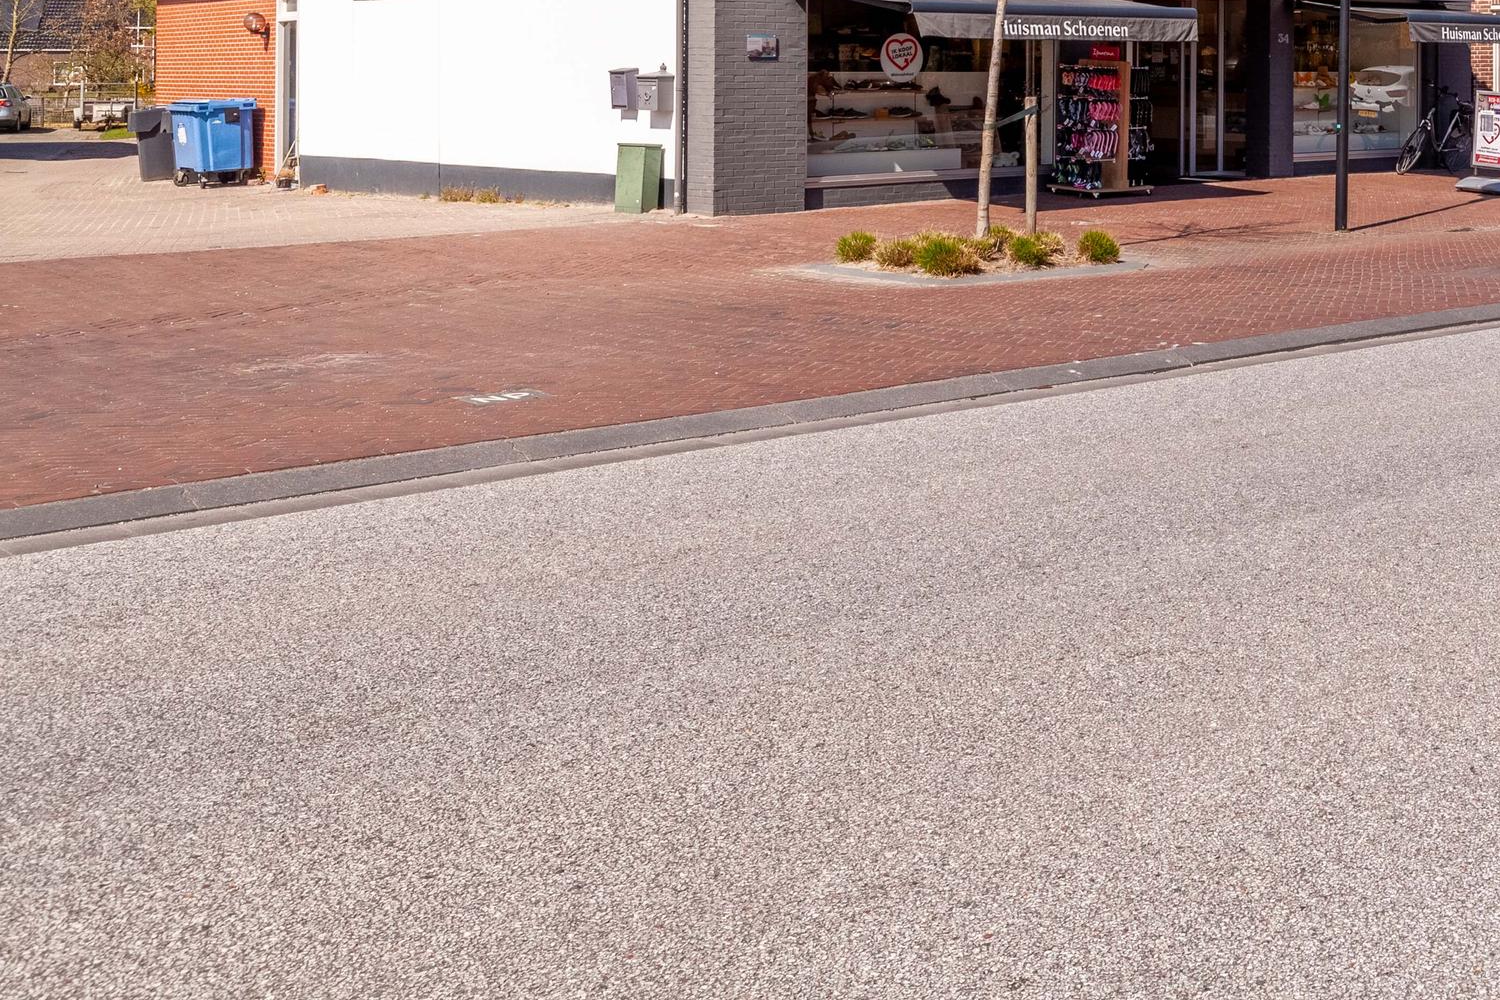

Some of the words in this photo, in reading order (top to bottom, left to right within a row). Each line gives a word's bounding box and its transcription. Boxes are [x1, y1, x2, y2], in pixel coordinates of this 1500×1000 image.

[1064, 20, 1129, 37] Schoenen
[1441, 26, 1482, 41] Huisman
[1277, 32, 1289, 44] 34
